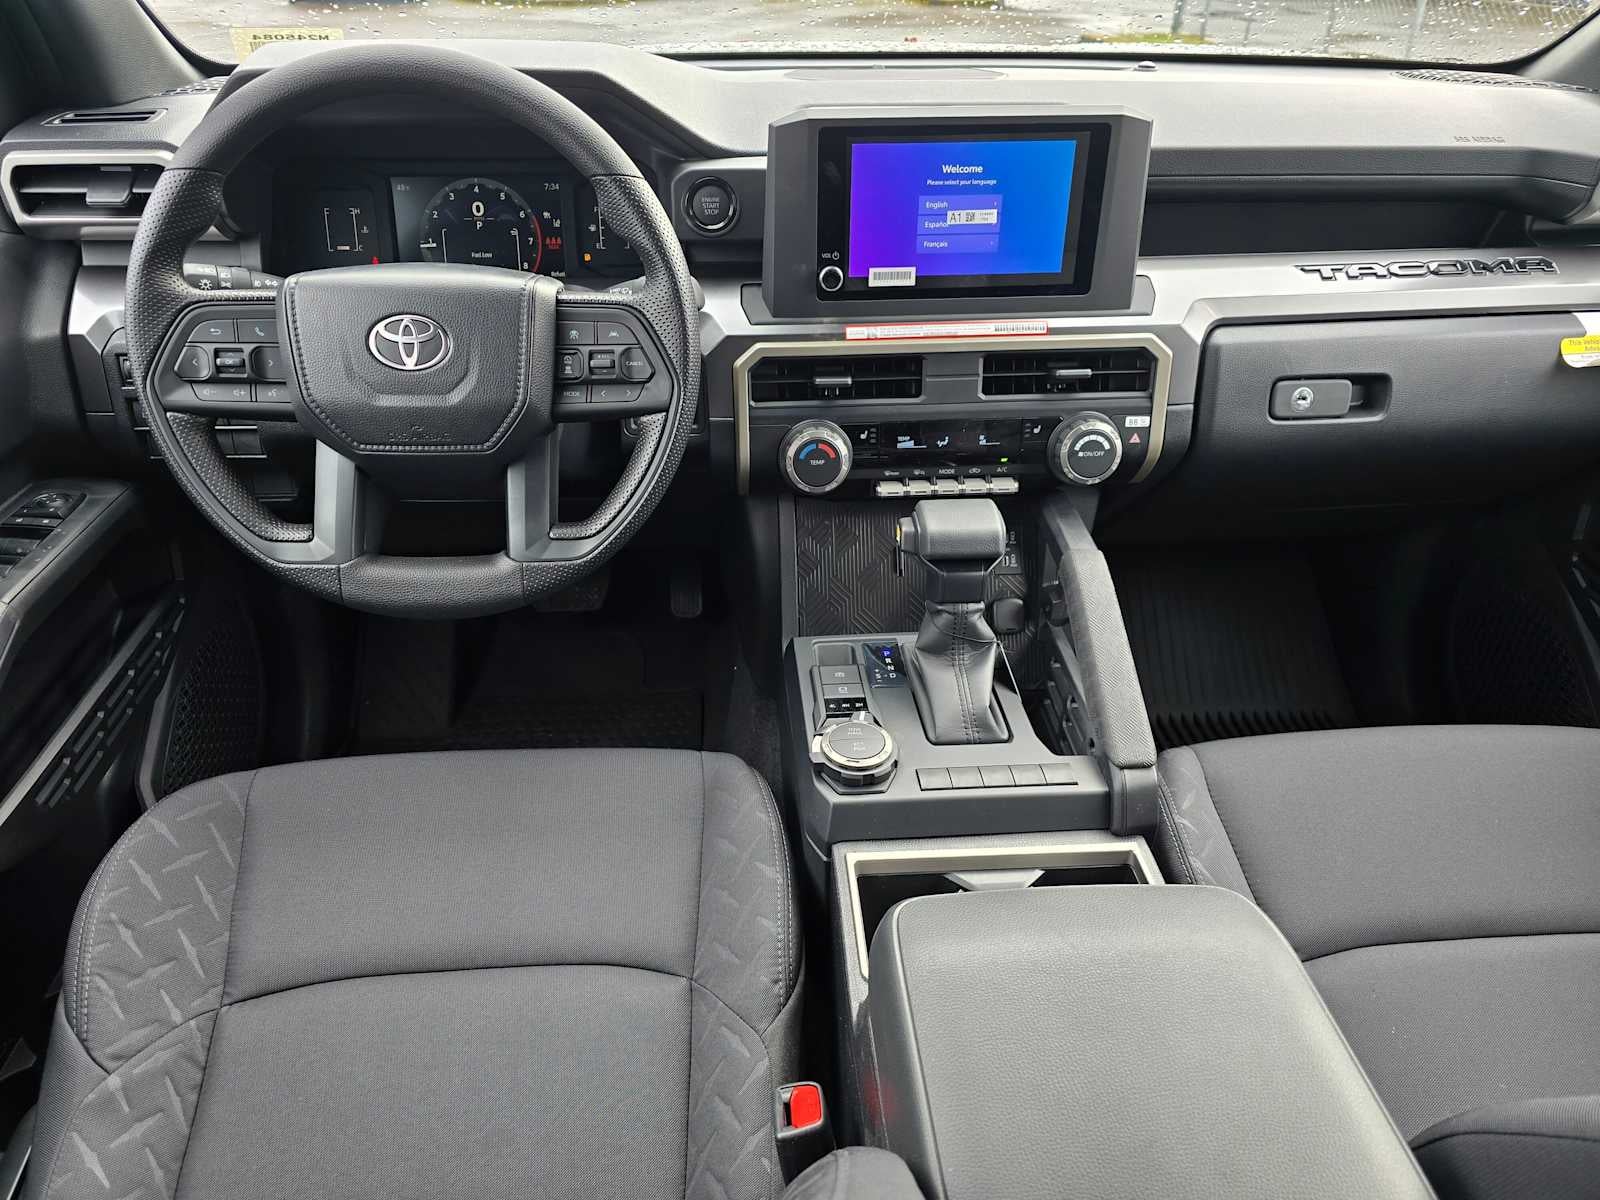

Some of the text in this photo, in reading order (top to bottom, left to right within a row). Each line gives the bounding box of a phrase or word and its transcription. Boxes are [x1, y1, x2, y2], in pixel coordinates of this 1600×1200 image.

[942, 164, 983, 173] Welcome
[544, 183, 559, 191] 7:34
[500, 192, 506, 200] 5
[472, 201, 485, 216] 0
[926, 201, 948, 209] English
[432, 210, 439, 218] 2
[519, 210, 526, 218] 6
[950, 213, 961, 222] A1
[476, 221, 483, 230] P
[528, 237, 533, 245] 7
[1293, 256, 1560, 281] TACOMA
